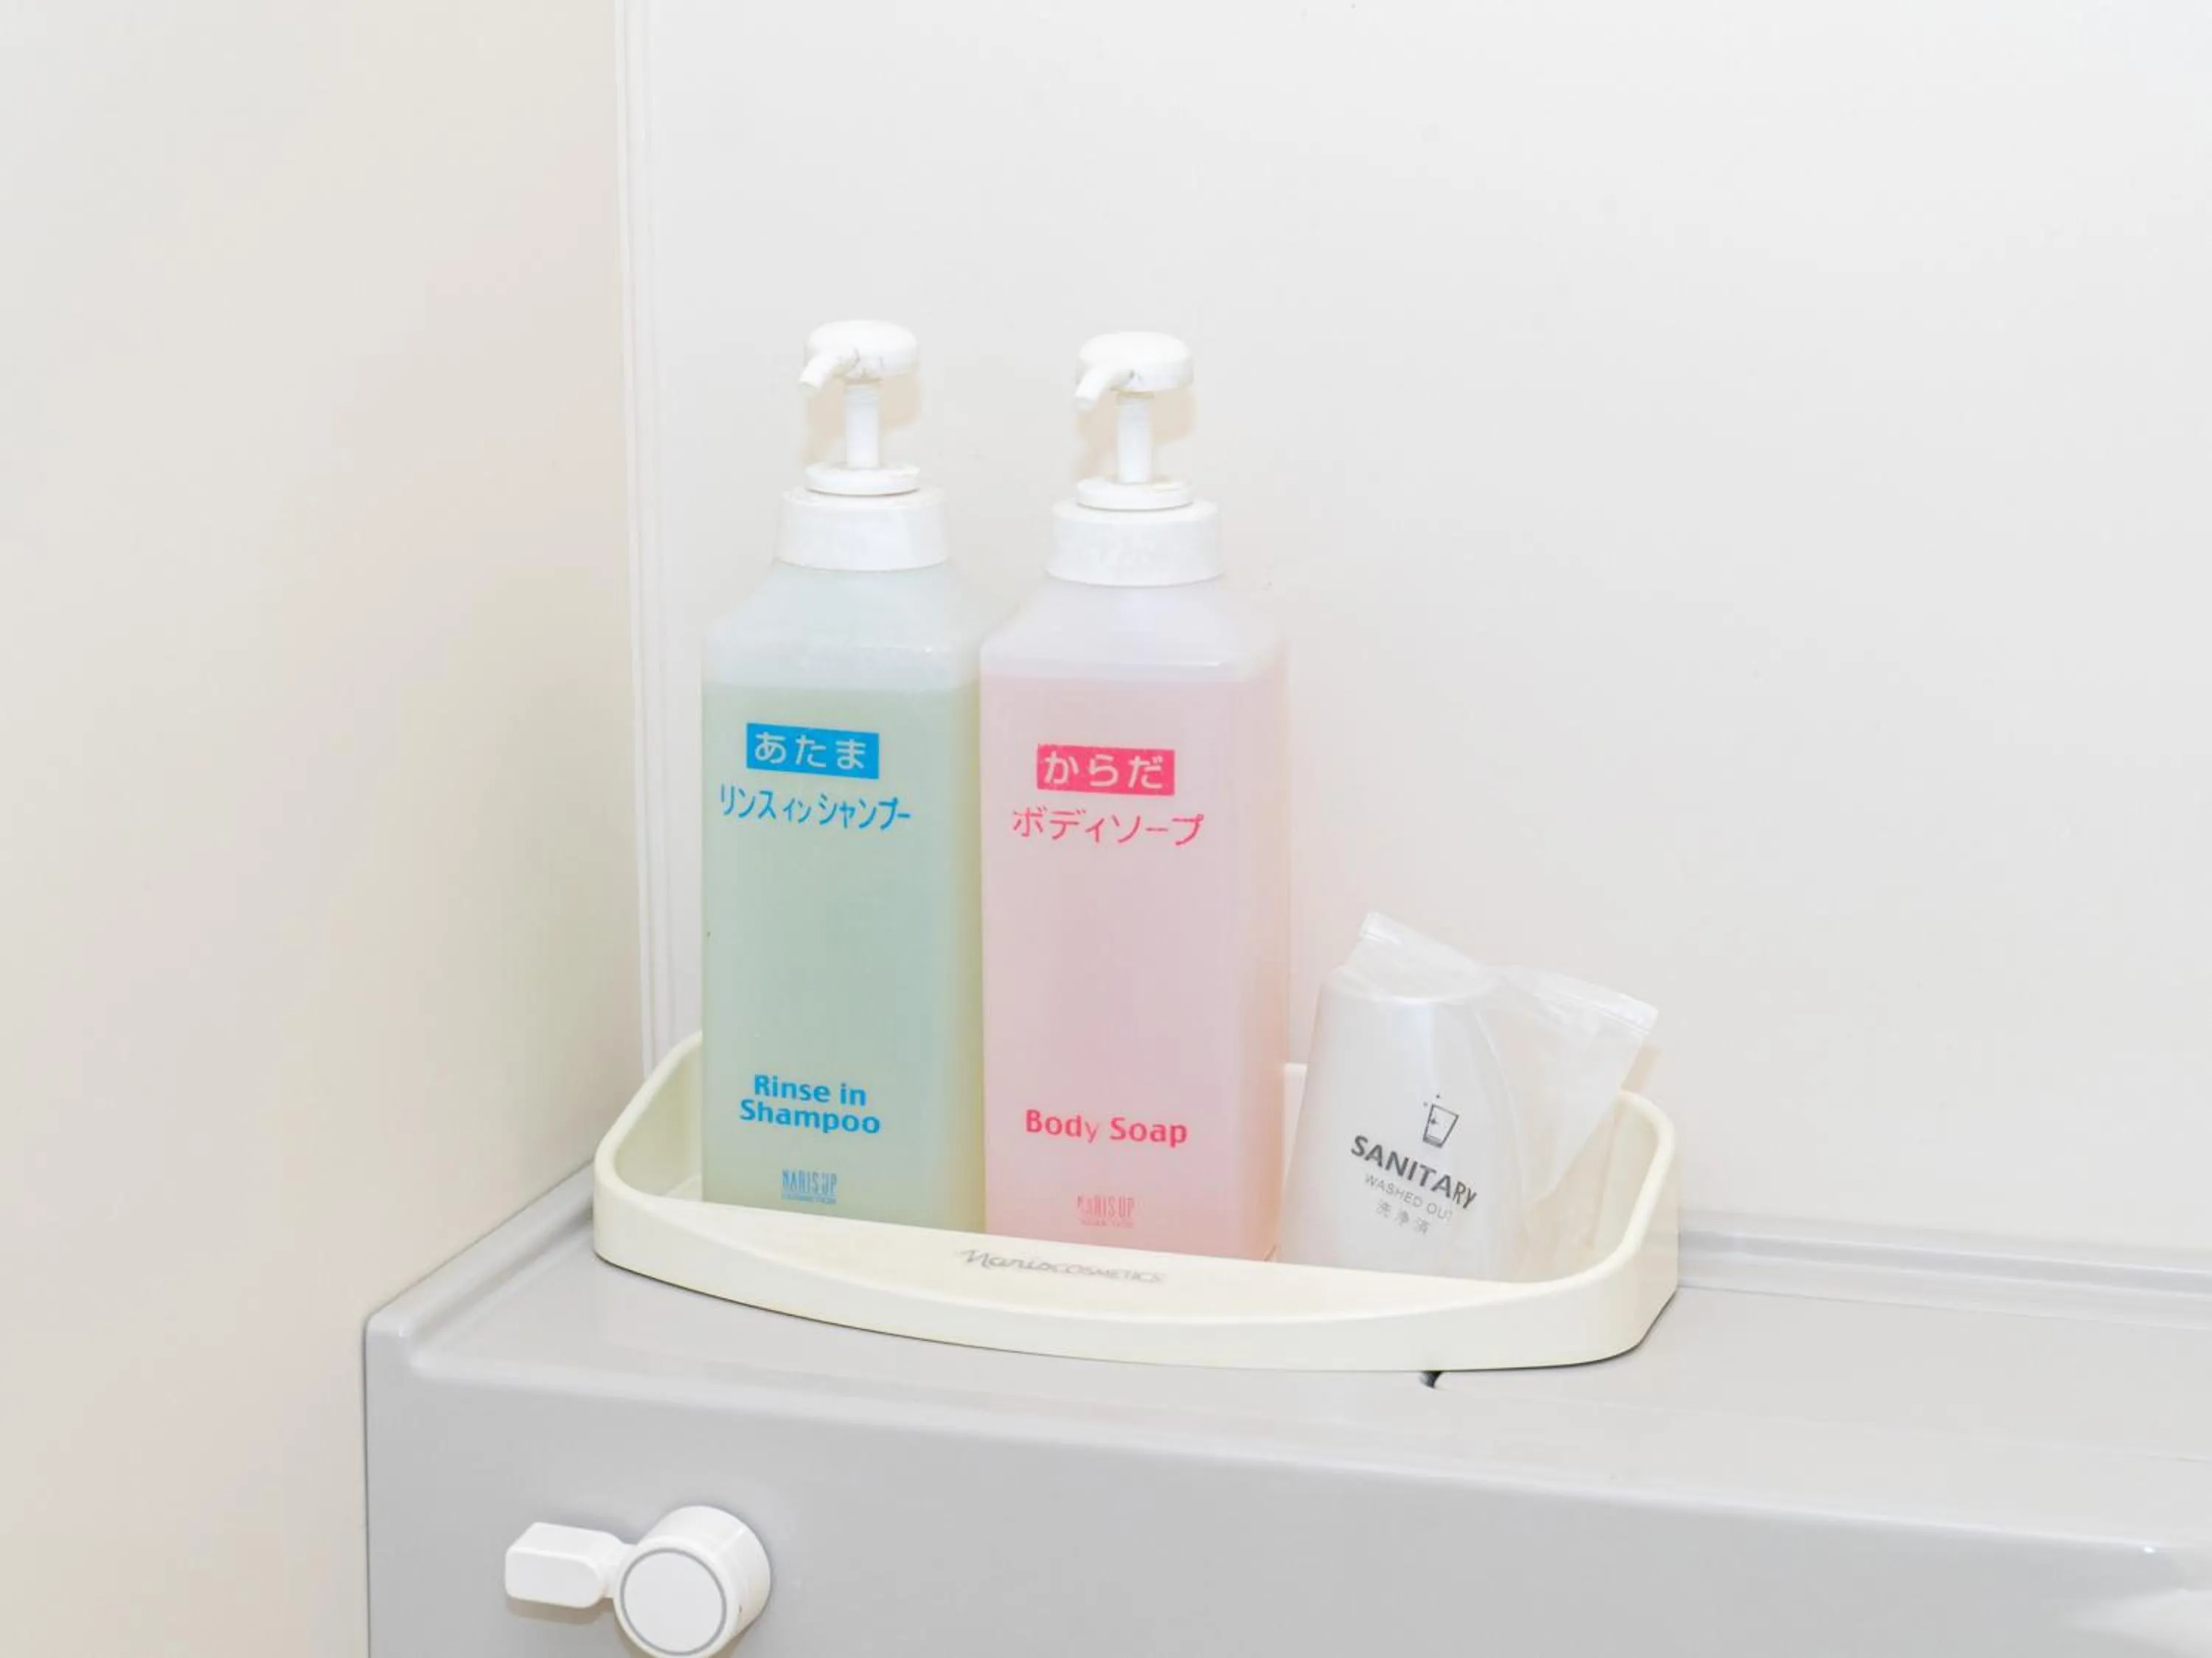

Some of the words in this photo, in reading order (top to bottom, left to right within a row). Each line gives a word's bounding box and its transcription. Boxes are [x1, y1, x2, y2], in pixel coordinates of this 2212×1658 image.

[754, 732, 866, 770] あたま
[1044, 750, 1164, 789] からだ
[1012, 805, 1204, 846] ボディソープ
[754, 1073, 831, 1103] Rinse
[839, 1082, 868, 1106] in
[740, 1098, 880, 1134] Shampoo
[1026, 1109, 1099, 1144] Body
[1109, 1116, 1188, 1148] Soap
[1351, 1135, 1478, 1210] SANITARY
[1365, 1173, 1423, 1207] WASHED
